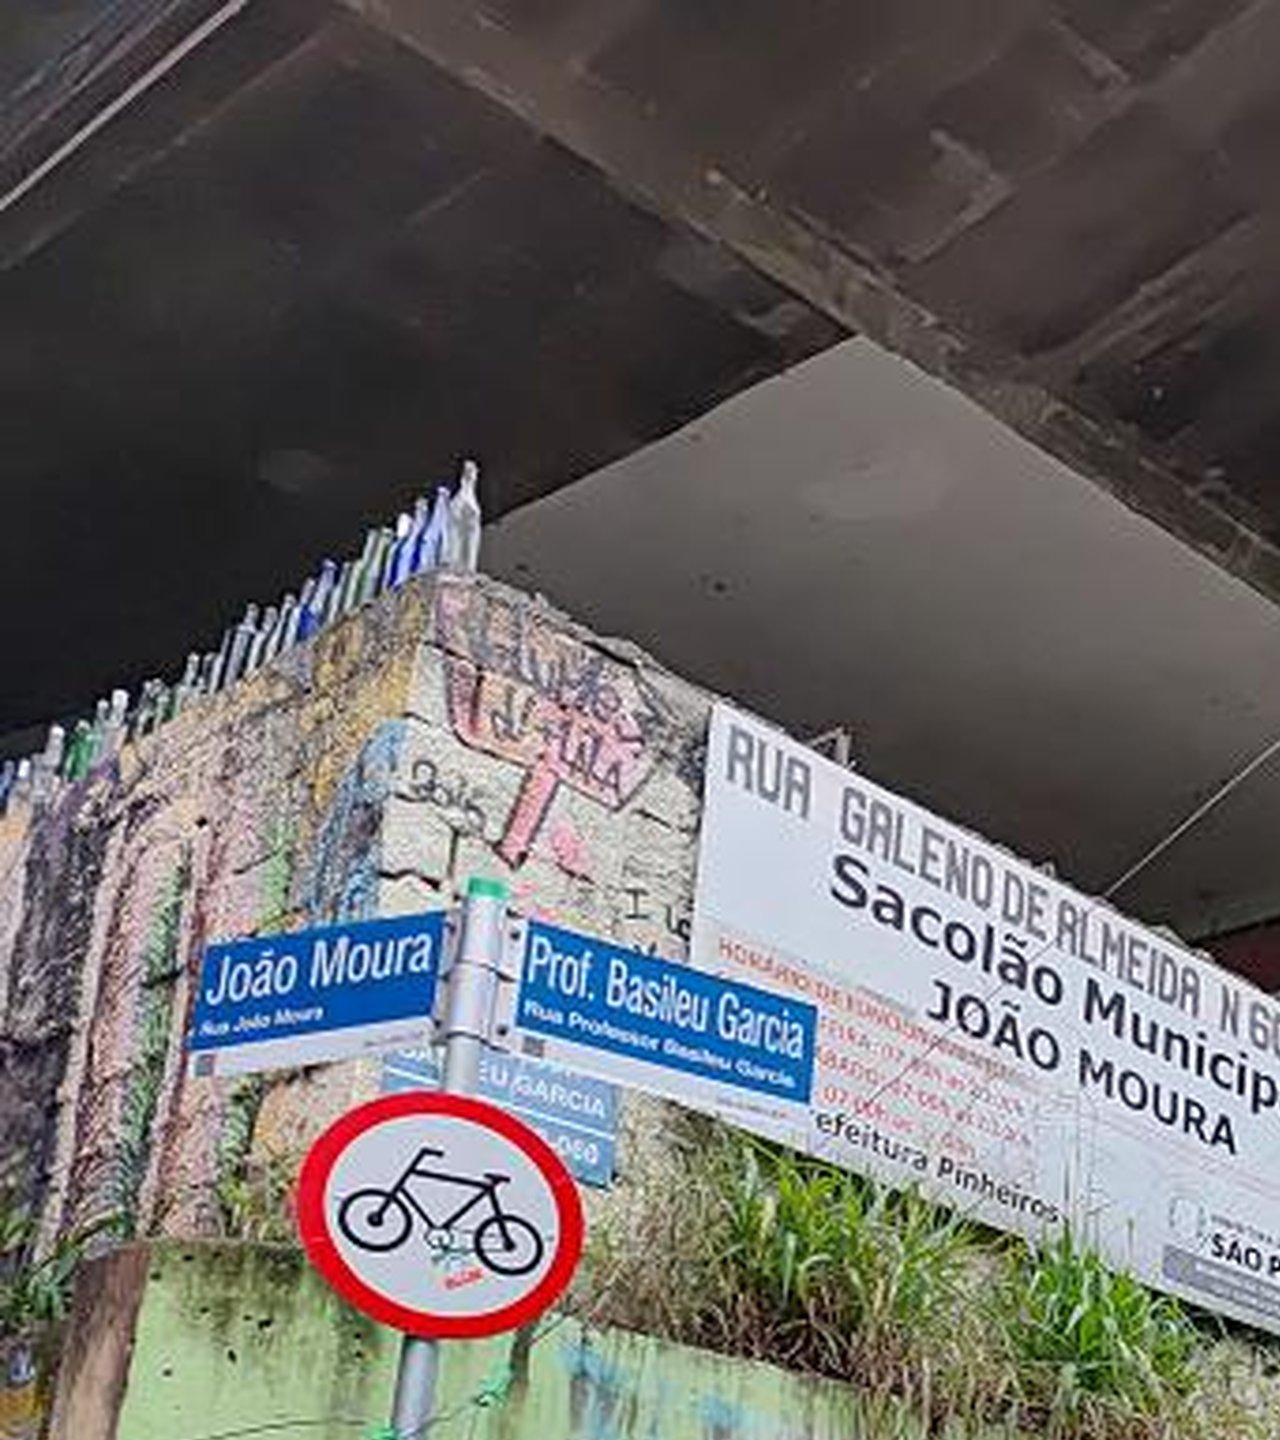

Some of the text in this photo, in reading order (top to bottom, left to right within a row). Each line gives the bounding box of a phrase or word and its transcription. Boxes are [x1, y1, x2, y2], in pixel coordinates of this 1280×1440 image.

[726, 723, 811, 820] RUA
[840, 786, 994, 912] GALENO
[1002, 869, 1048, 942] DE
[1055, 899, 1201, 1018] ALMEIDA
[205, 931, 433, 1006] João Moura
[831, 854, 1063, 1005] Sacolão
[200, 1006, 324, 1037] Rua João Moura
[523, 999, 797, 1088] Rua Professor Basileu Garcia
[527, 936, 805, 1058] Prof. Basileu Garcia
[512, 1074, 606, 1119] GARCIA
[926, 978, 1061, 1071] JOÃO
[1079, 1050, 1237, 1154] MOURA
[813, 1111, 929, 1172] efeitura
[936, 1157, 1060, 1225] Pinheiros
